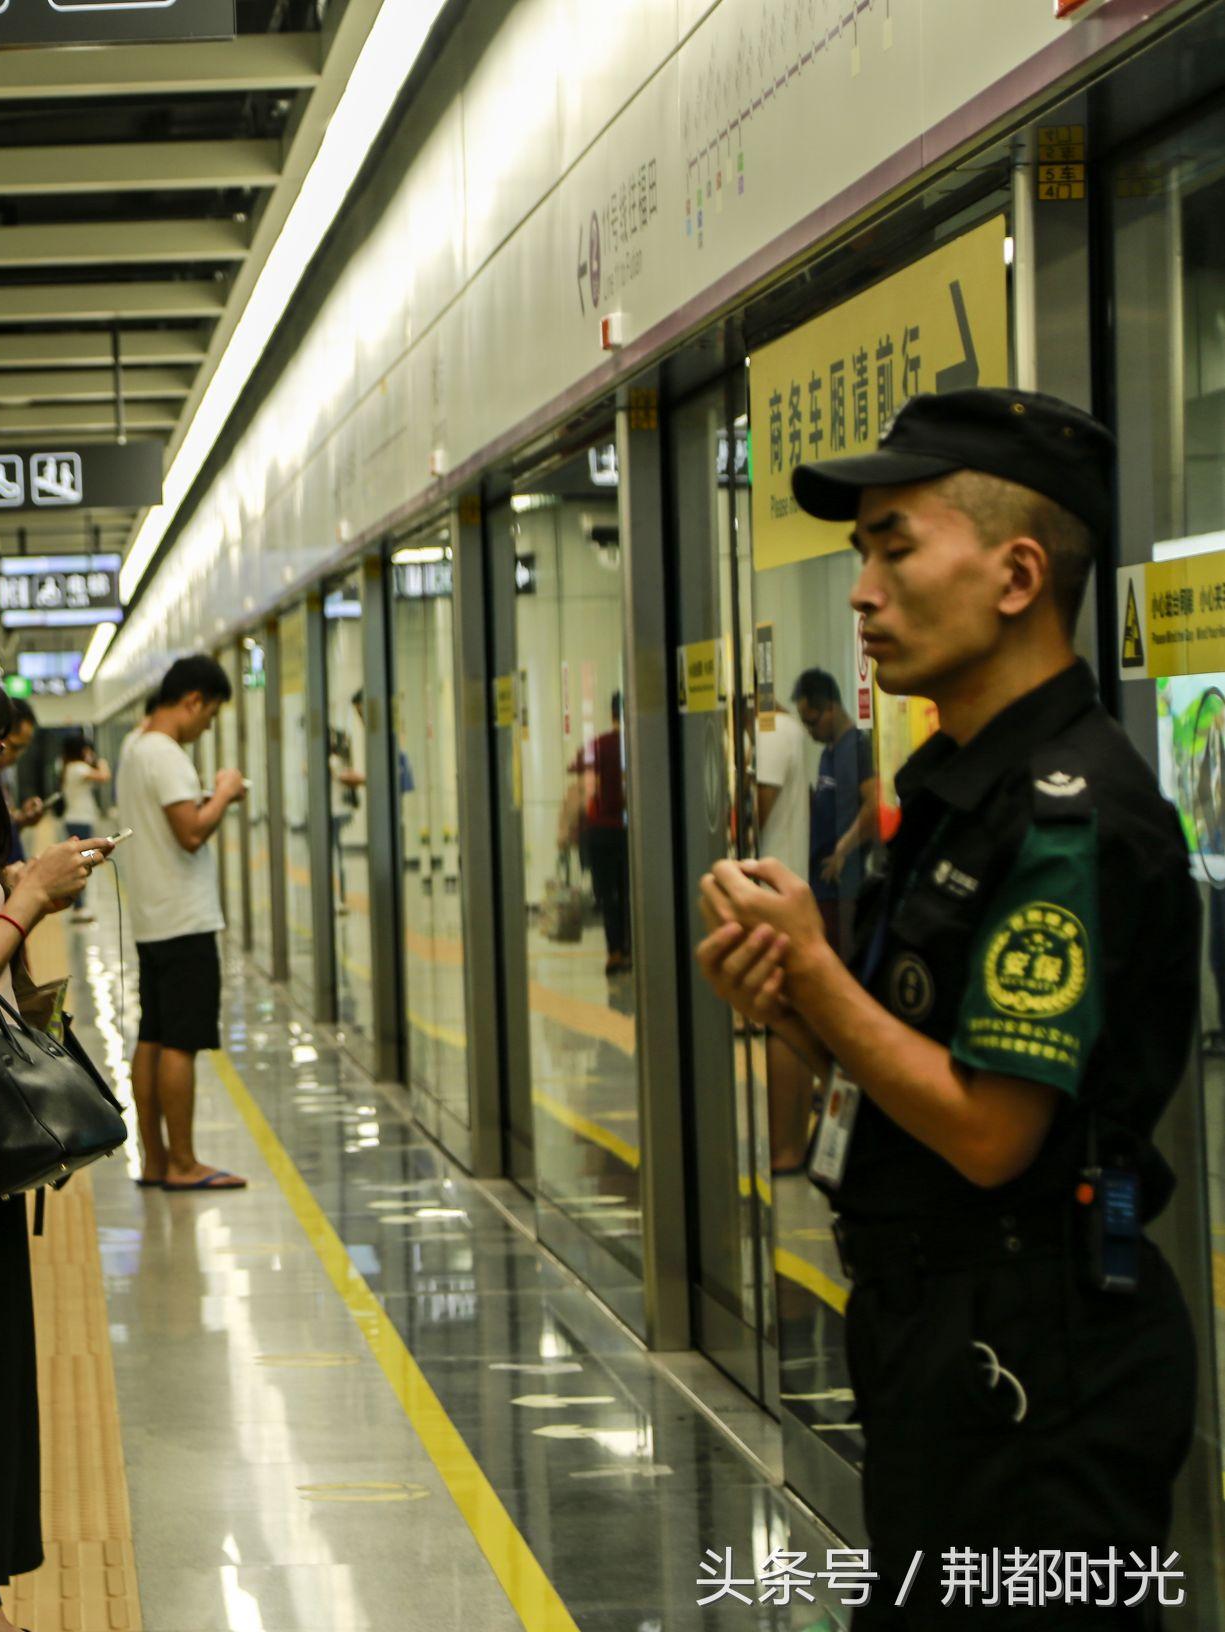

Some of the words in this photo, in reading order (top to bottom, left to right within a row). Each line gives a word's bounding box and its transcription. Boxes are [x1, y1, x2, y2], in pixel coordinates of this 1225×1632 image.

[769, 325, 921, 476] 商务车厢请前行
